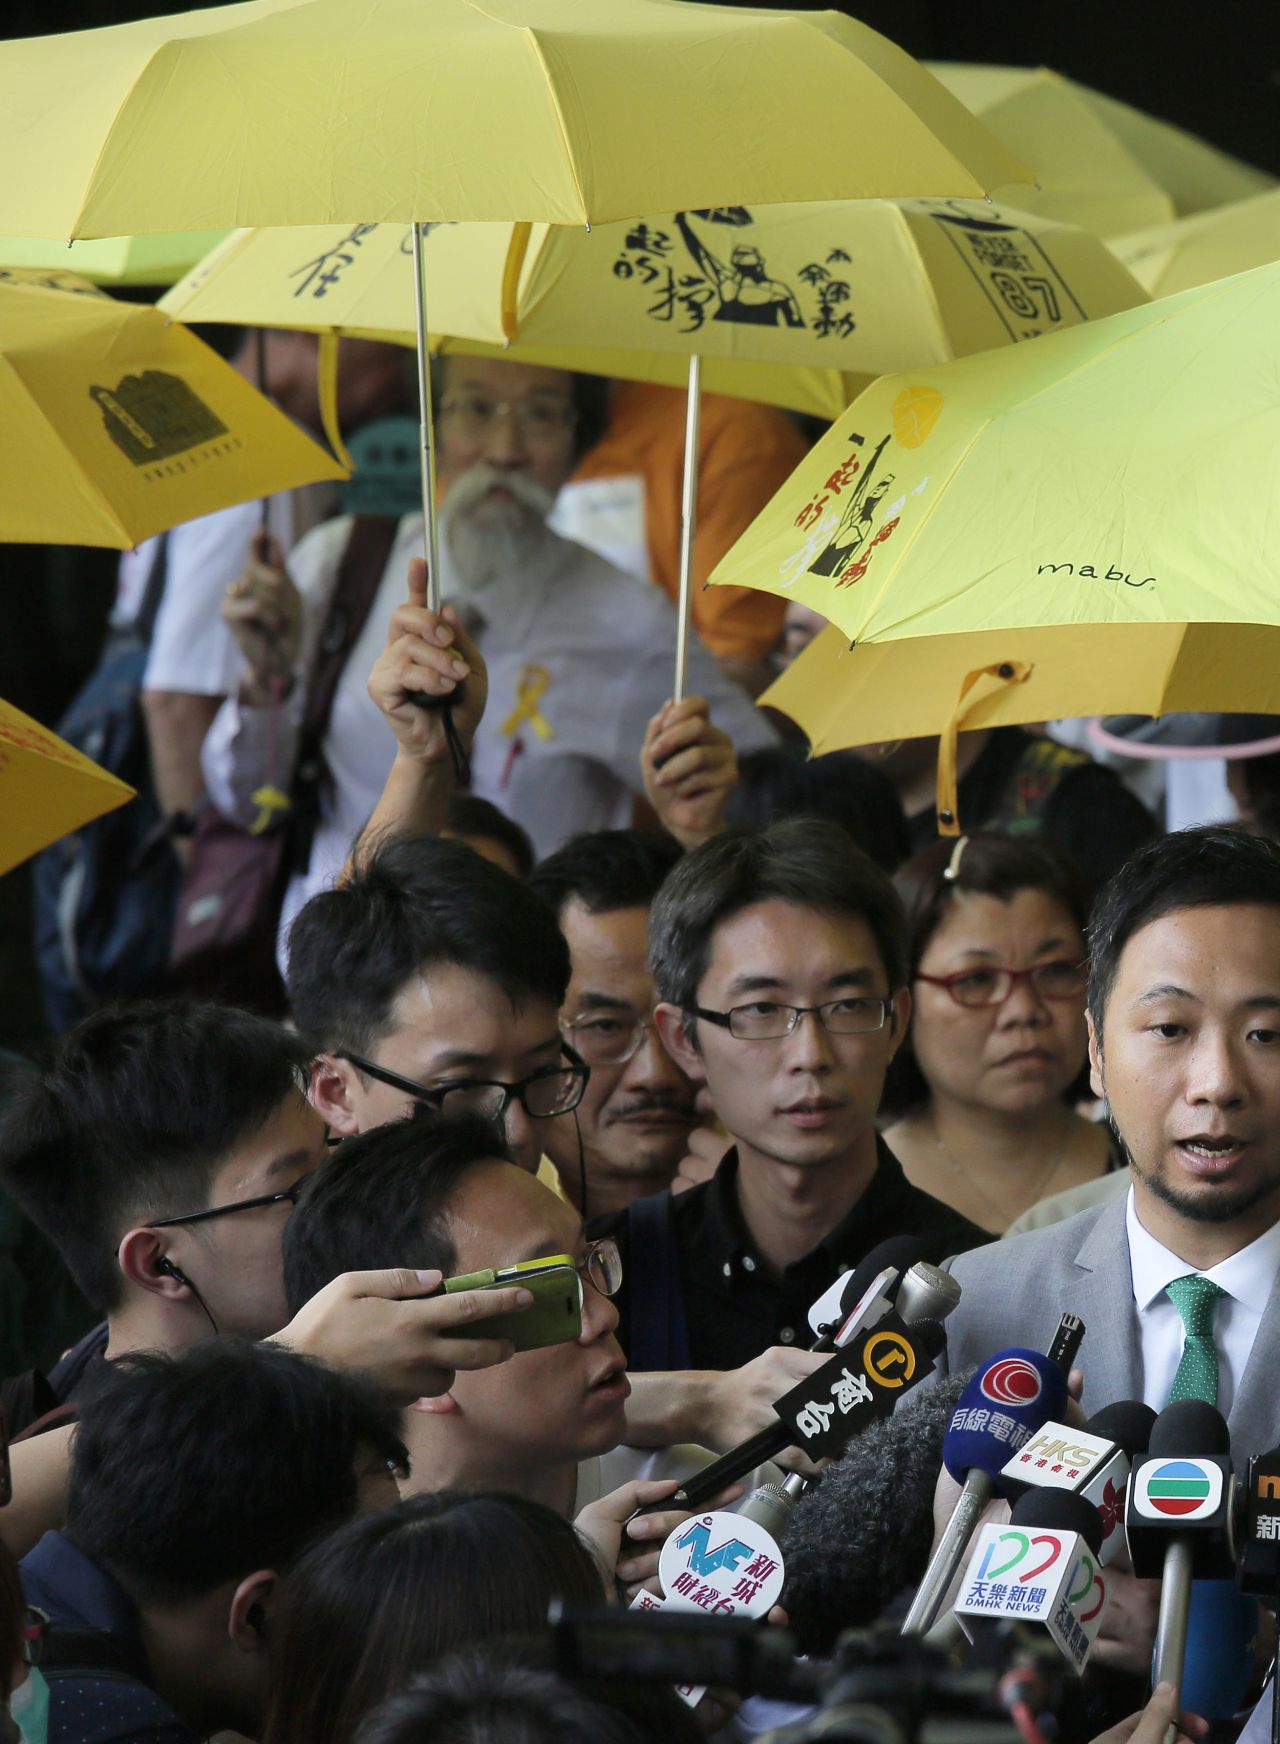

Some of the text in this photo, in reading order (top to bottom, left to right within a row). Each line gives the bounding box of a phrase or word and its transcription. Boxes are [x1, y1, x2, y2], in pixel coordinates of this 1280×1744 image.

[991, 272, 1062, 323] 87
[796, 1367, 873, 1439] 商台
[1019, 1453, 1080, 1479] 香港衛視
[1026, 1435, 1099, 1468] HKS
[730, 1553, 780, 1605] 新城
[968, 1581, 1048, 1605] 天樂新聞
[965, 1598, 1041, 1613] DMHK NEWS
